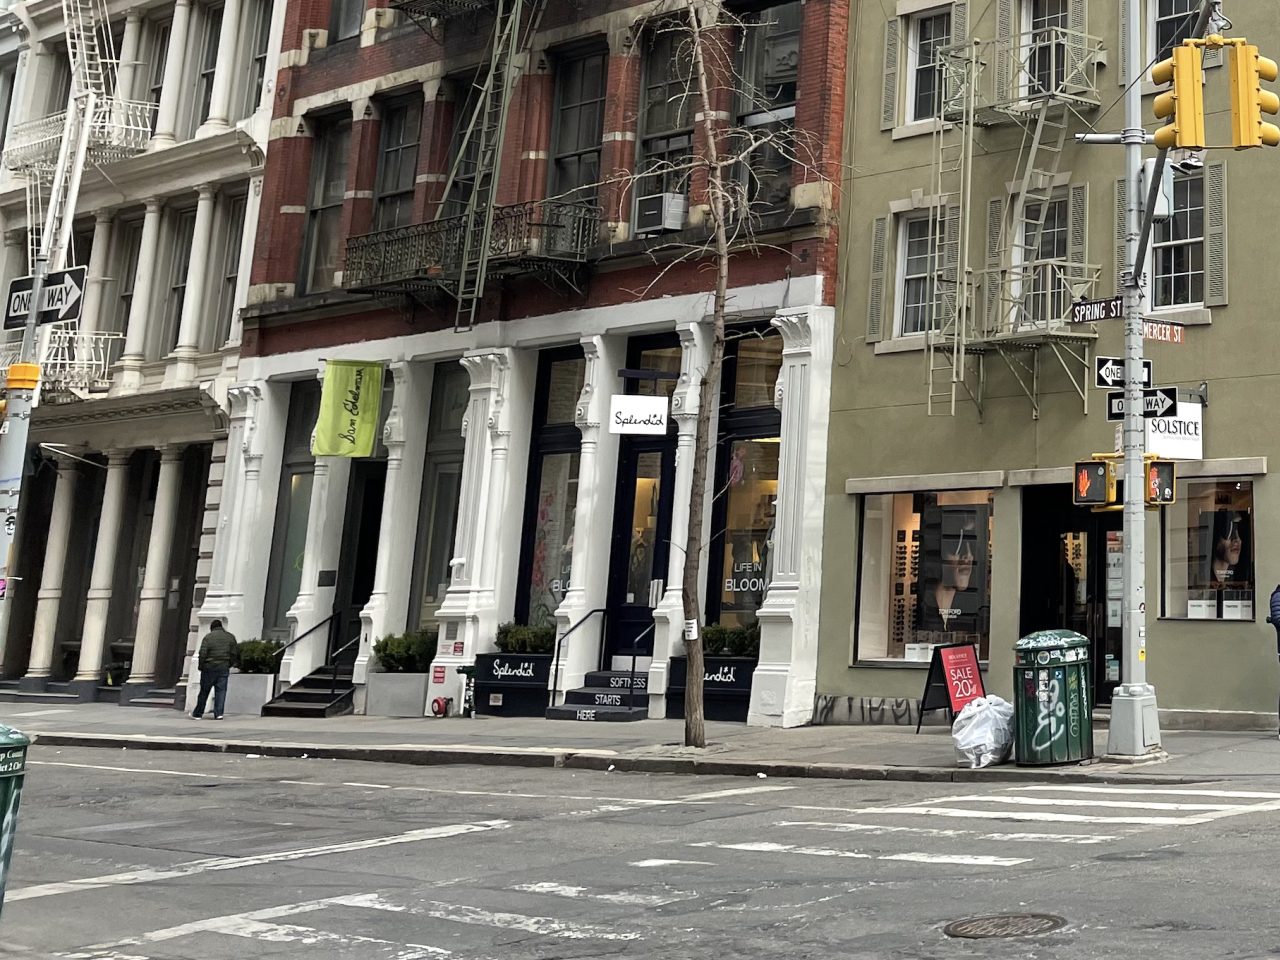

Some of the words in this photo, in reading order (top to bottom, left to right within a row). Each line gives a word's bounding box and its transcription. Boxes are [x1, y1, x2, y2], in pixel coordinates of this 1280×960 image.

[47, 285, 73, 308] WAY
[1074, 303, 1105, 323] SPRING
[1110, 300, 1122, 318] ST
[1143, 322, 1171, 341] MERCER
[1173, 326, 1182, 342] ST
[1104, 367, 1121, 379] ONE
[343, 368, 364, 416] Edelman
[1145, 397, 1166, 410] WAY
[615, 411, 664, 428] Splendid
[1151, 418, 1200, 436] SOLSTICE
[338, 419, 356, 445] Sam
[735, 562, 752, 573] LIFE
[753, 562, 762, 572] IN
[553, 579, 571, 592] BLO
[725, 578, 769, 591] BLOOM
[493, 658, 535, 679] Splendid
[703, 666, 736, 683] endid
[949, 666, 973, 681] SALE
[595, 694, 621, 706] STARTS
[576, 709, 597, 721] HERE
